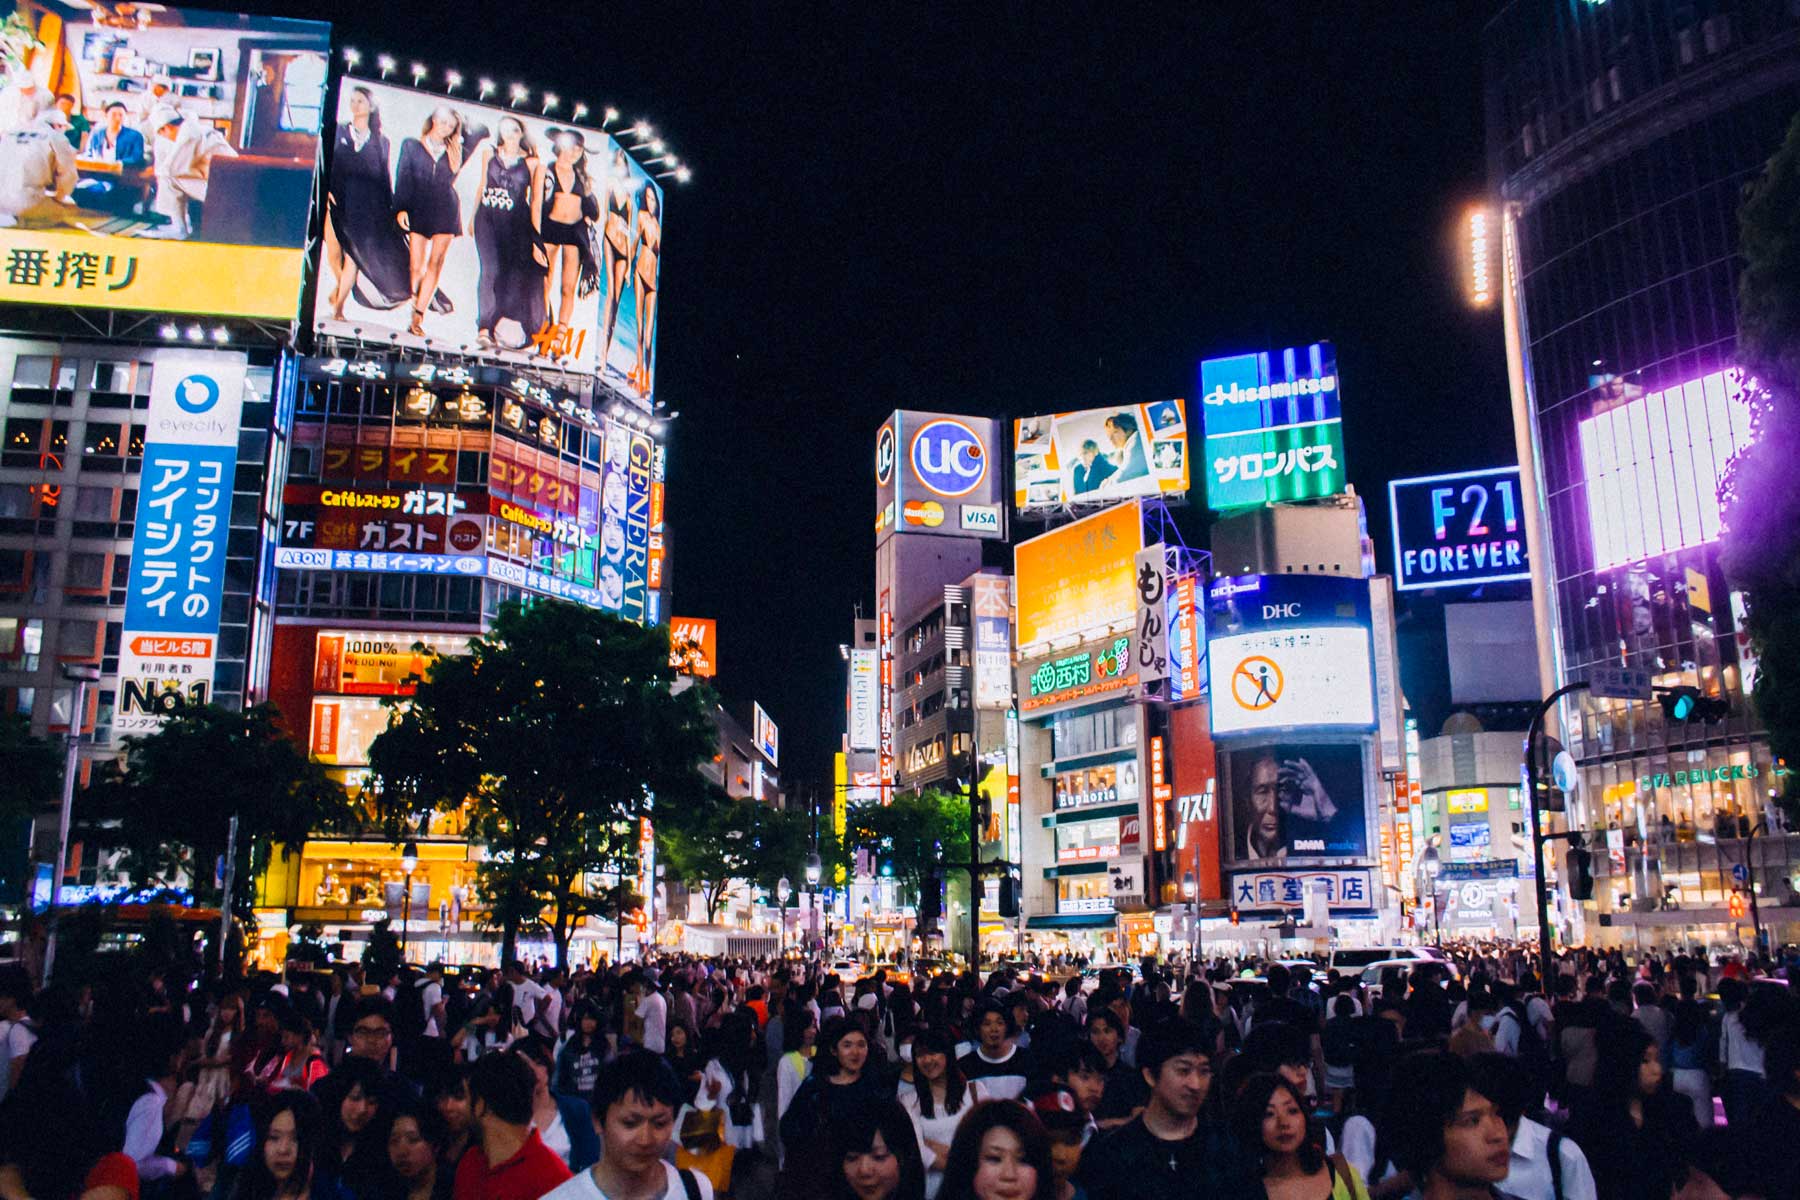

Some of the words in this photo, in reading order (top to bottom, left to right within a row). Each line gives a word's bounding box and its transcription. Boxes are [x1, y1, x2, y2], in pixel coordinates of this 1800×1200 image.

[1203, 376, 1335, 405] Hisamitsu
[160, 420, 227, 435] eyecity
[1213, 444, 1337, 483] サロンパス
[491, 458, 575, 507] コンタクト
[402, 490, 466, 516] ガスト
[1432, 480, 1517, 540] F21
[966, 512, 997, 524] VISA
[141, 459, 190, 617] アイシティ
[183, 461, 222, 618] コンタクトの
[285, 520, 315, 538] 7F
[360, 520, 437, 550] ガスト
[552, 520, 592, 548] ガスト
[281, 551, 327, 565] AEON
[336, 552, 452, 571] 英会話イーオン
[1404, 540, 1521, 576] FOREVER
[491, 562, 522, 585] AEON
[1138, 562, 1166, 675] もんじゃ
[1262, 603, 1301, 620] DHC
[140, 639, 207, 655] 当ビル5階
[346, 641, 398, 655] 1000%
[1056, 661, 1090, 689] 西村
[1641, 762, 1758, 791] STARBUCKS
[1059, 788, 1116, 808] Euphoria
